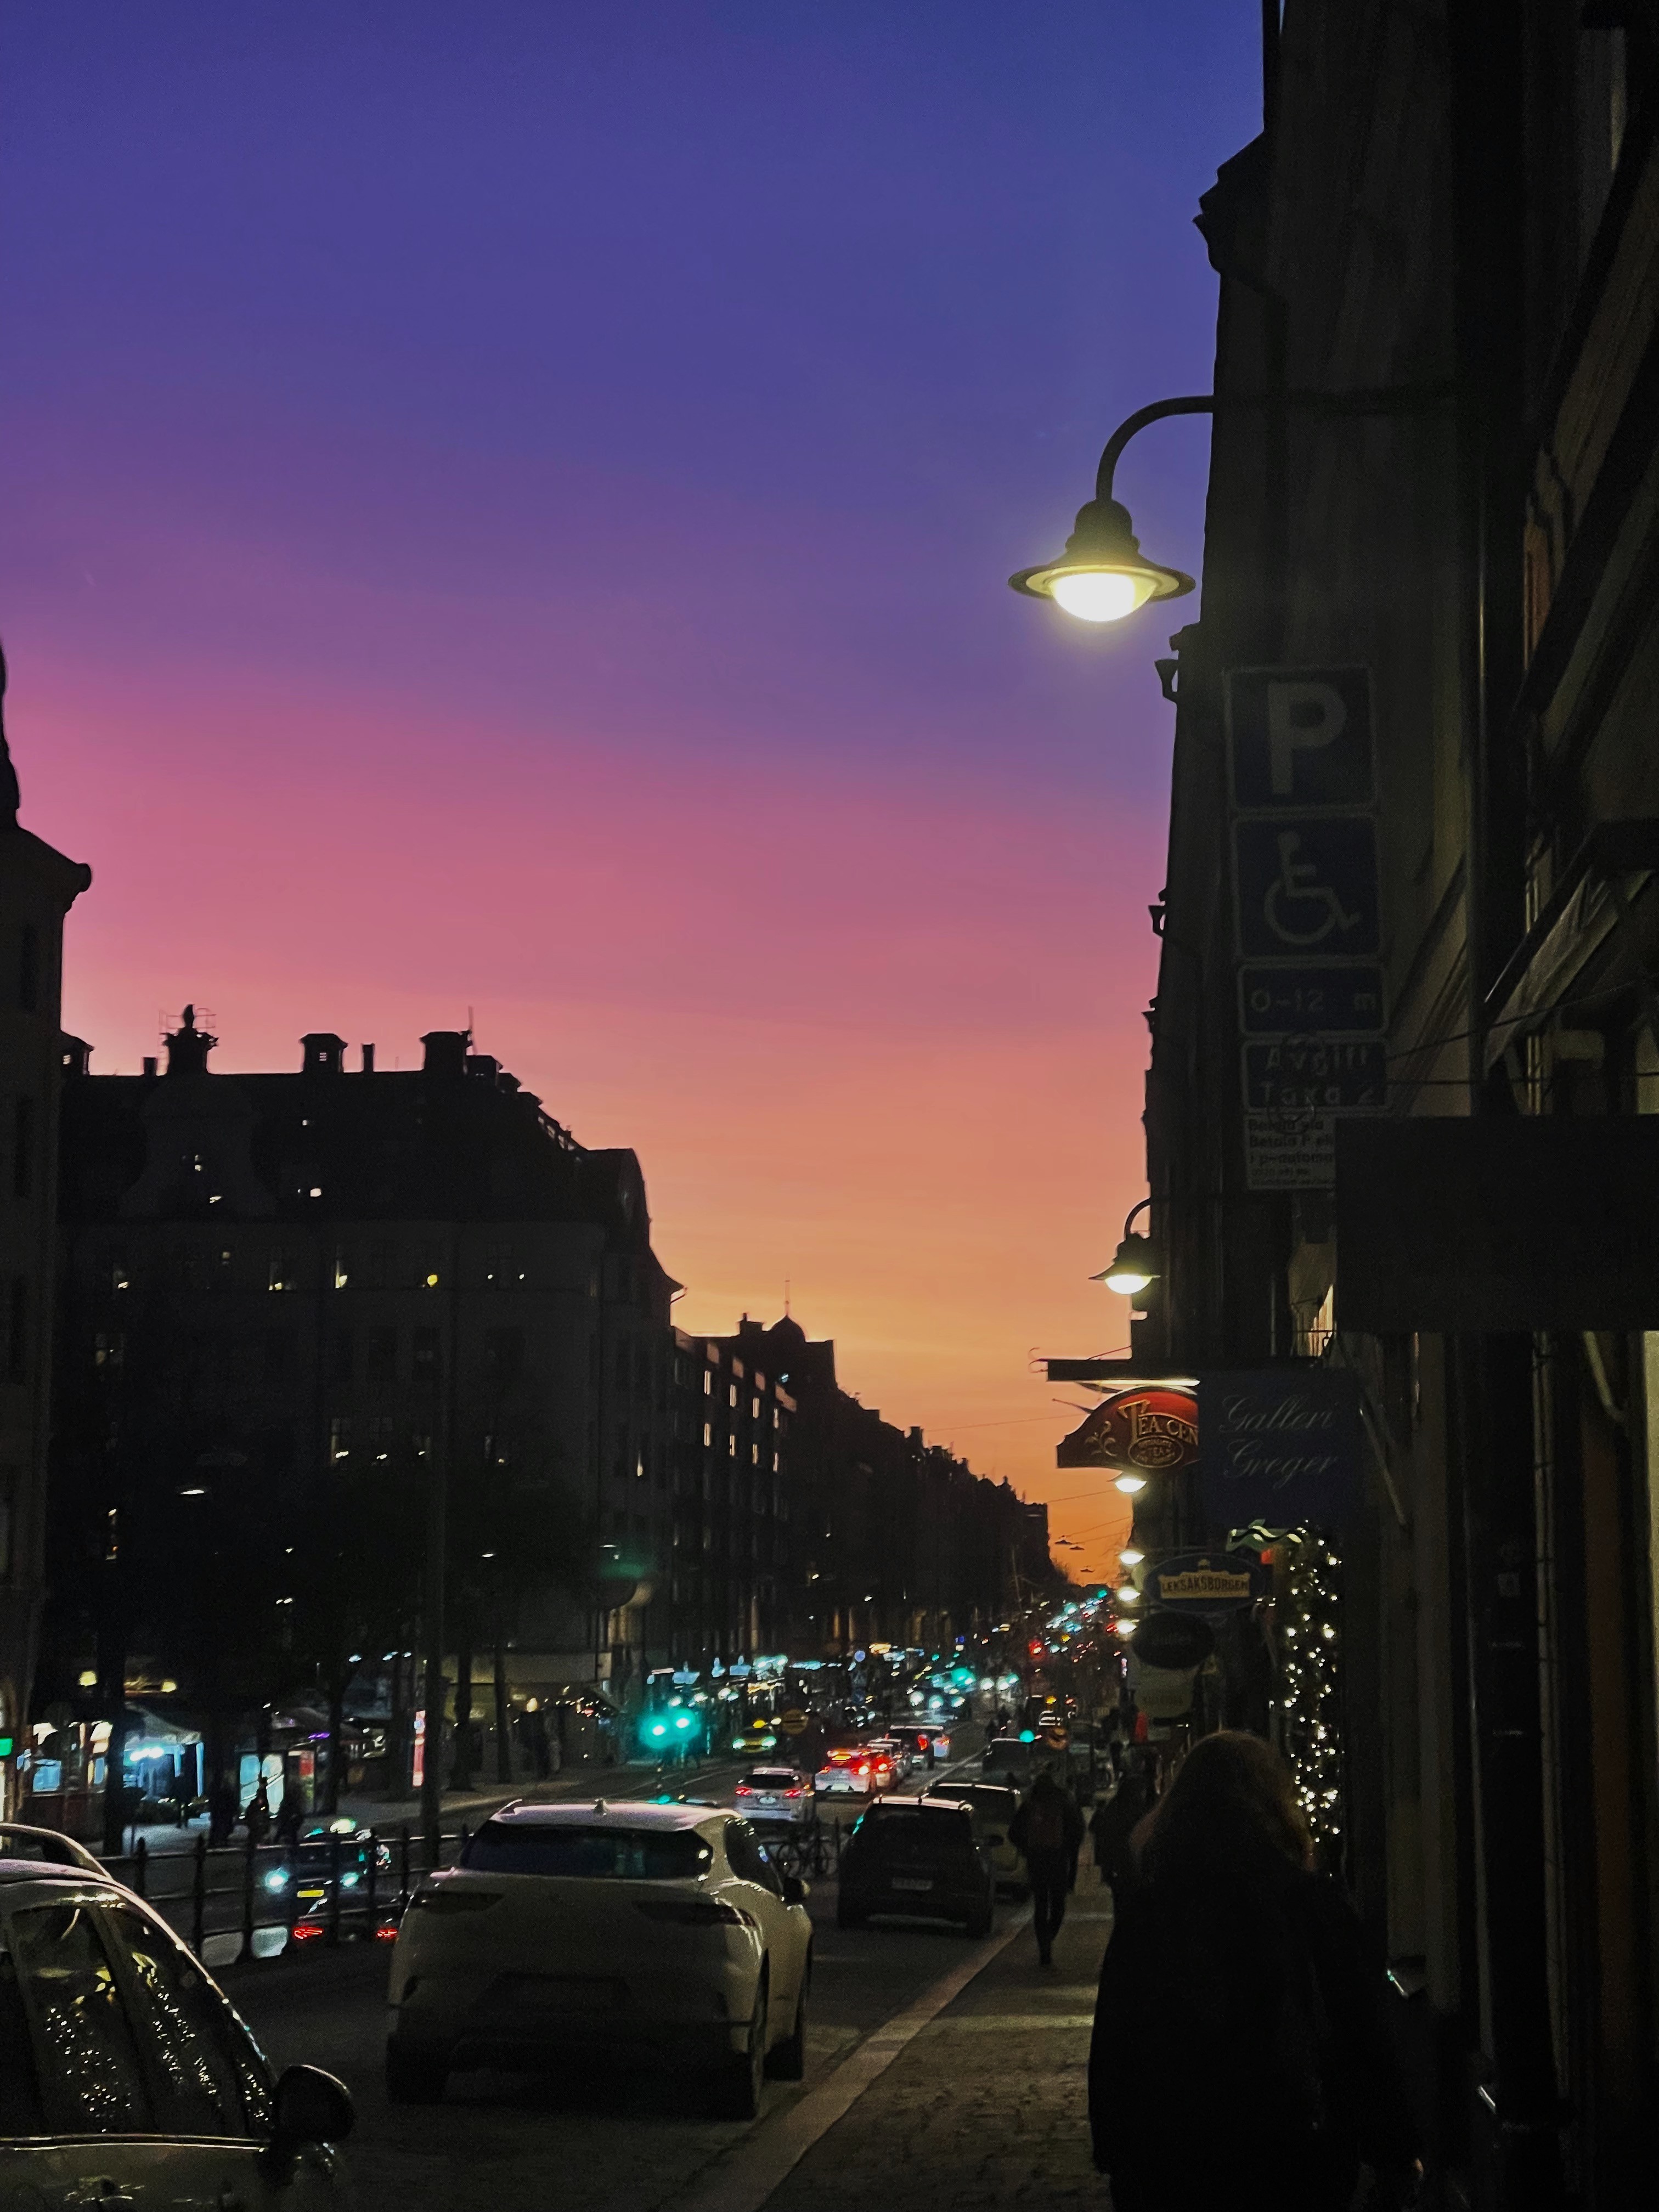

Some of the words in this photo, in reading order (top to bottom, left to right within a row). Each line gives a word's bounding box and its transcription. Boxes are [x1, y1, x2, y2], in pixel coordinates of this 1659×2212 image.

[1267, 682, 1347, 794] P
[1250, 988, 1324, 1013] 0-12
[1353, 992, 1376, 1011] m
[1118, 1399, 1163, 1443] TEA
[1218, 1393, 1340, 1433] Galleri
[1223, 1438, 1339, 1489] Greger
